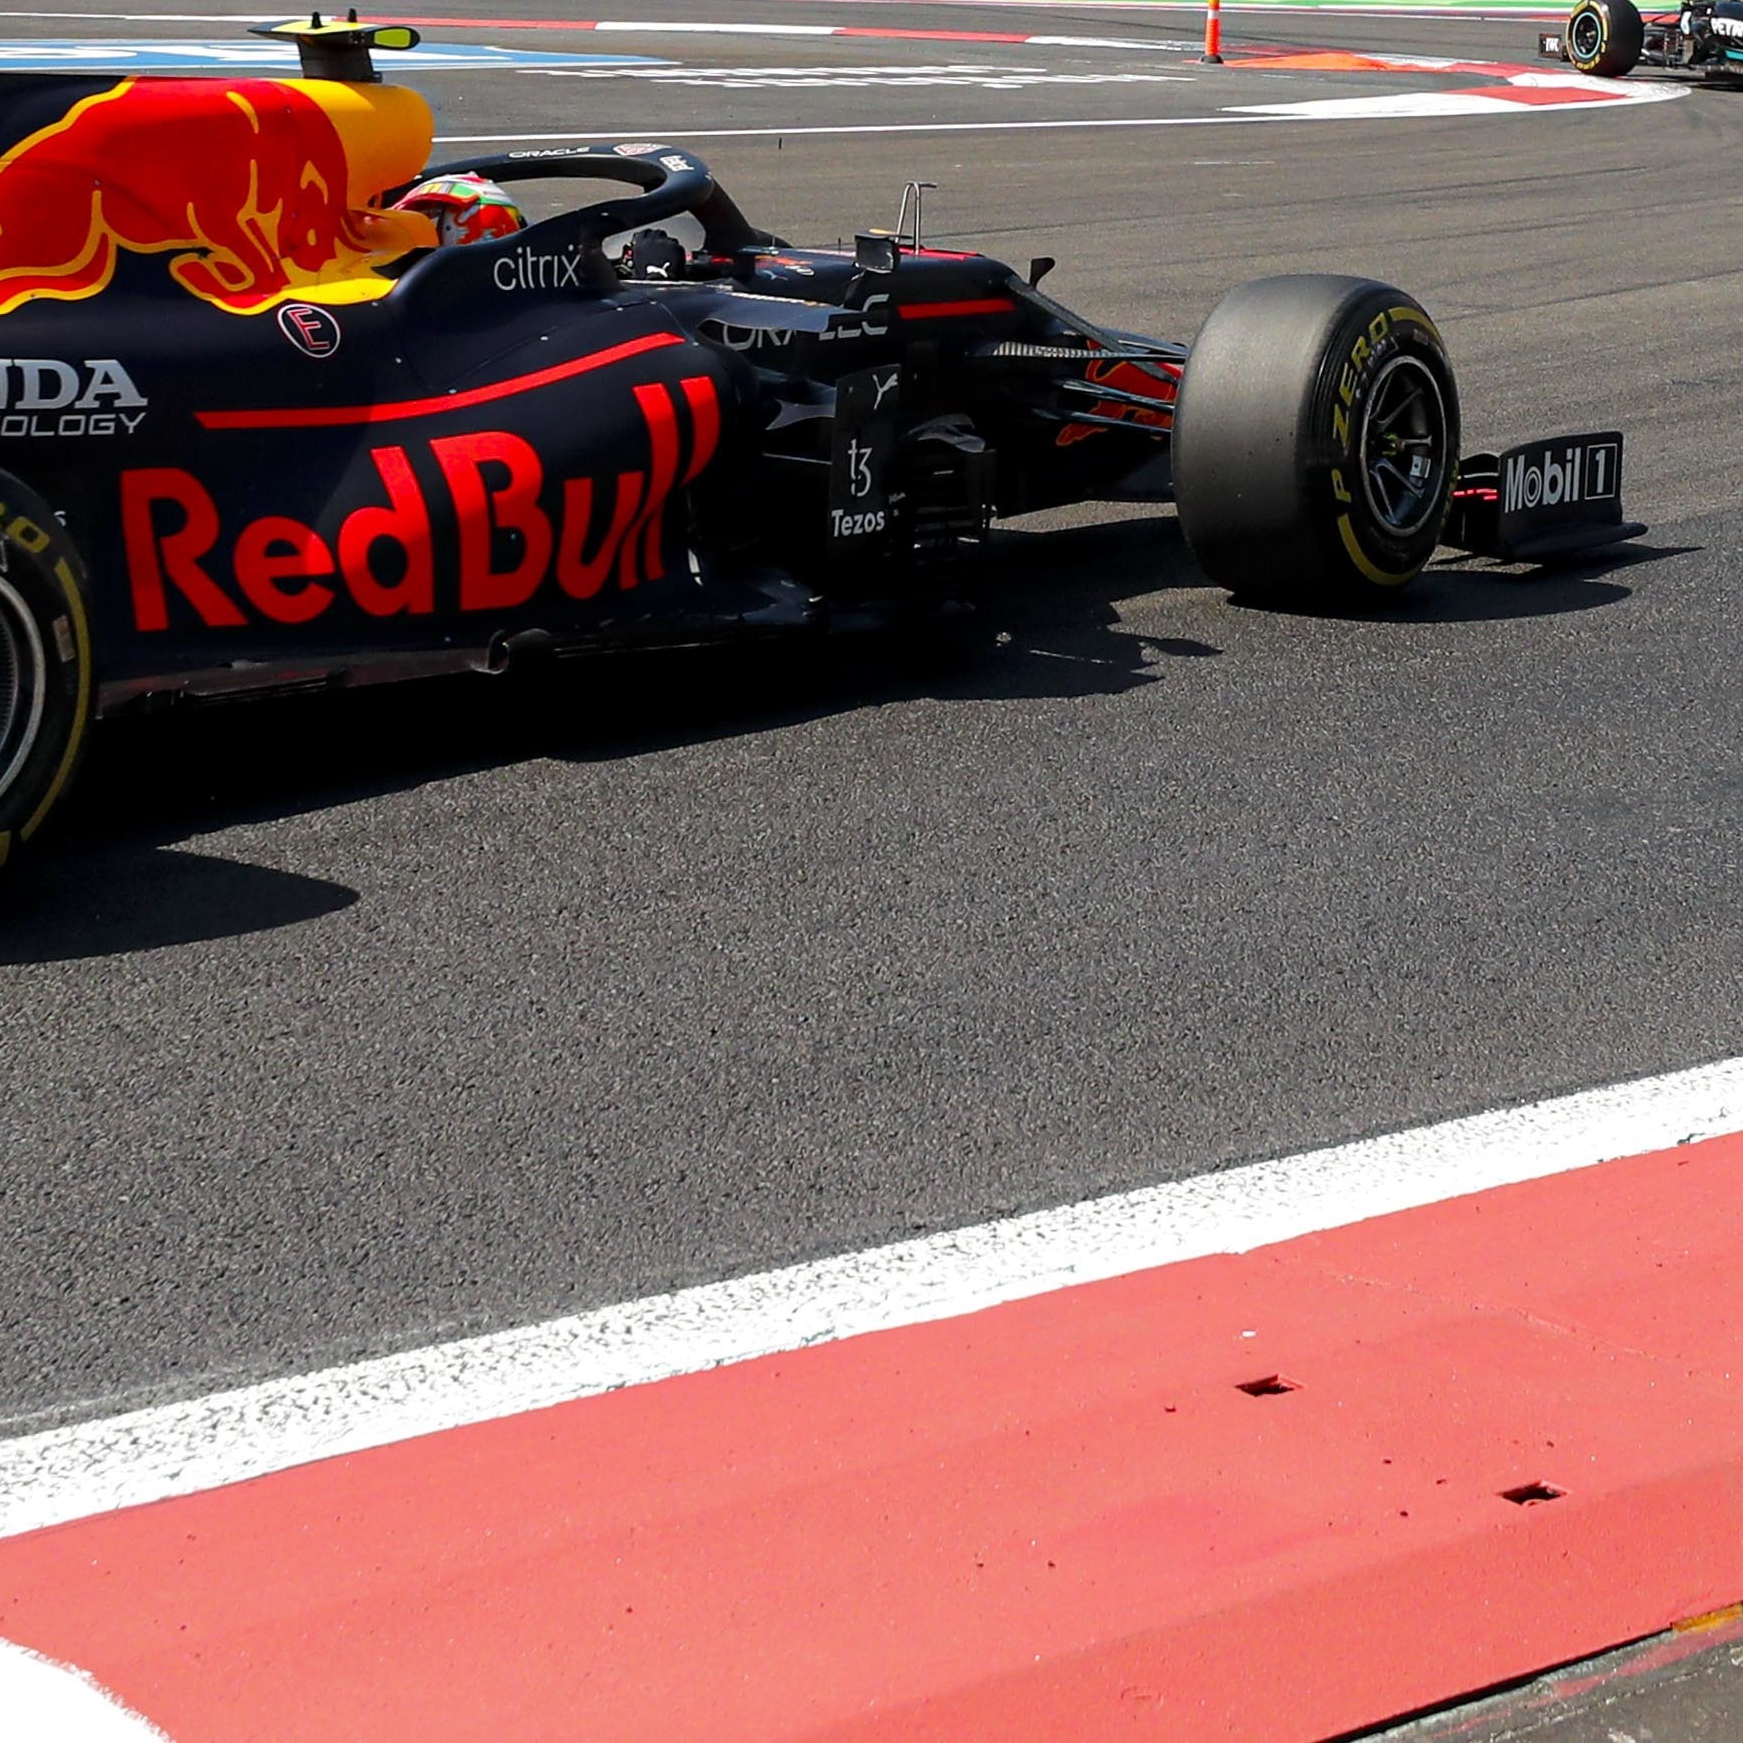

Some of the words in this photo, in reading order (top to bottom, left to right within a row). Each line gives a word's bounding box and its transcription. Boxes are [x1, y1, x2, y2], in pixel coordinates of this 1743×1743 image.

[509, 146, 590, 159] ORACLE
[494, 244, 581, 291] citrix
[1332, 311, 1389, 450] ZERO
[1333, 468, 1352, 504] P
[1504, 447, 1582, 514] Mobil
[831, 509, 885, 537] Tezos
